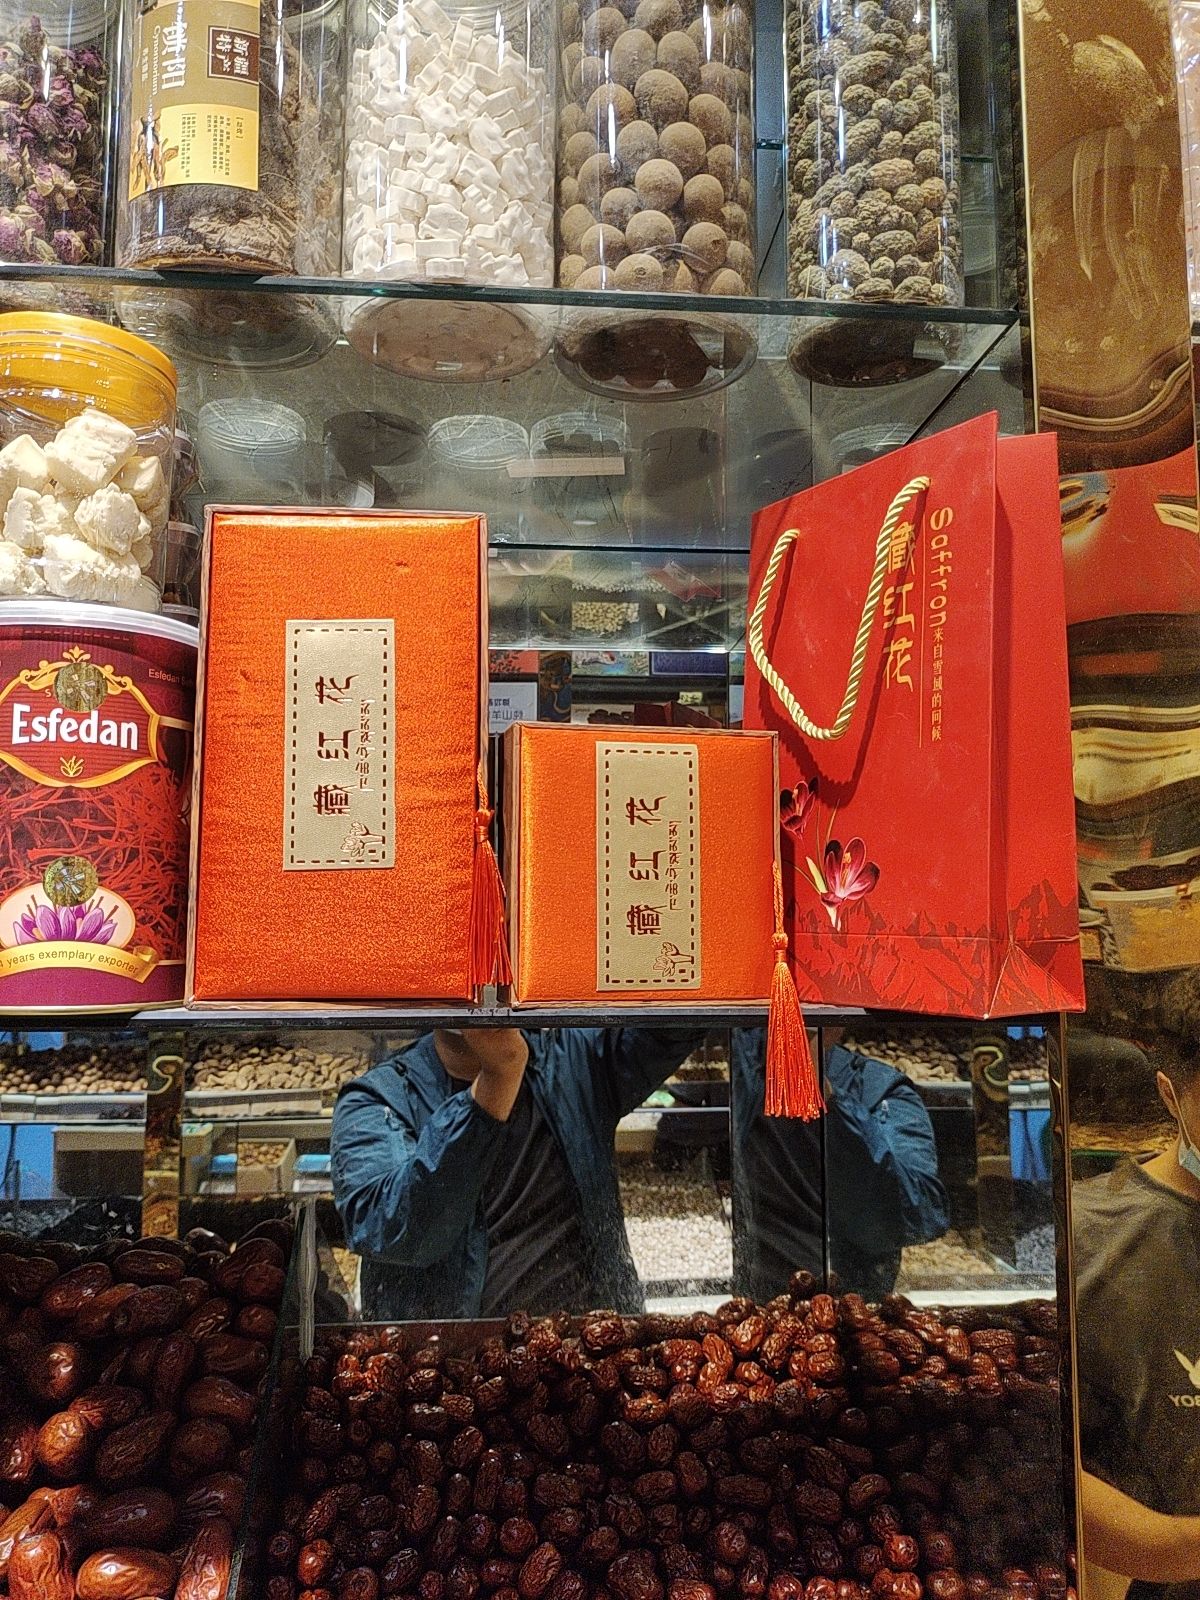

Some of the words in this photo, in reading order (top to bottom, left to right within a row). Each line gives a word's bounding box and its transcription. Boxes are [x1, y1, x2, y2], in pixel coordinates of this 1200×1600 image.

[152, 25, 161, 96] Cynomorium
[215, 33, 231, 72] 特产
[233, 36, 249, 76] 新疆
[929, 506, 954, 628] Saffron
[148, 668, 180, 683] Esfedan
[12, 703, 138, 751] Esfedan
[313, 674, 359, 816] 藏红花
[626, 796, 667, 935] 藏红花
[7, 953, 35, 969] years
[38, 949, 95, 963] exemplary
[98, 954, 139, 974] exporter
